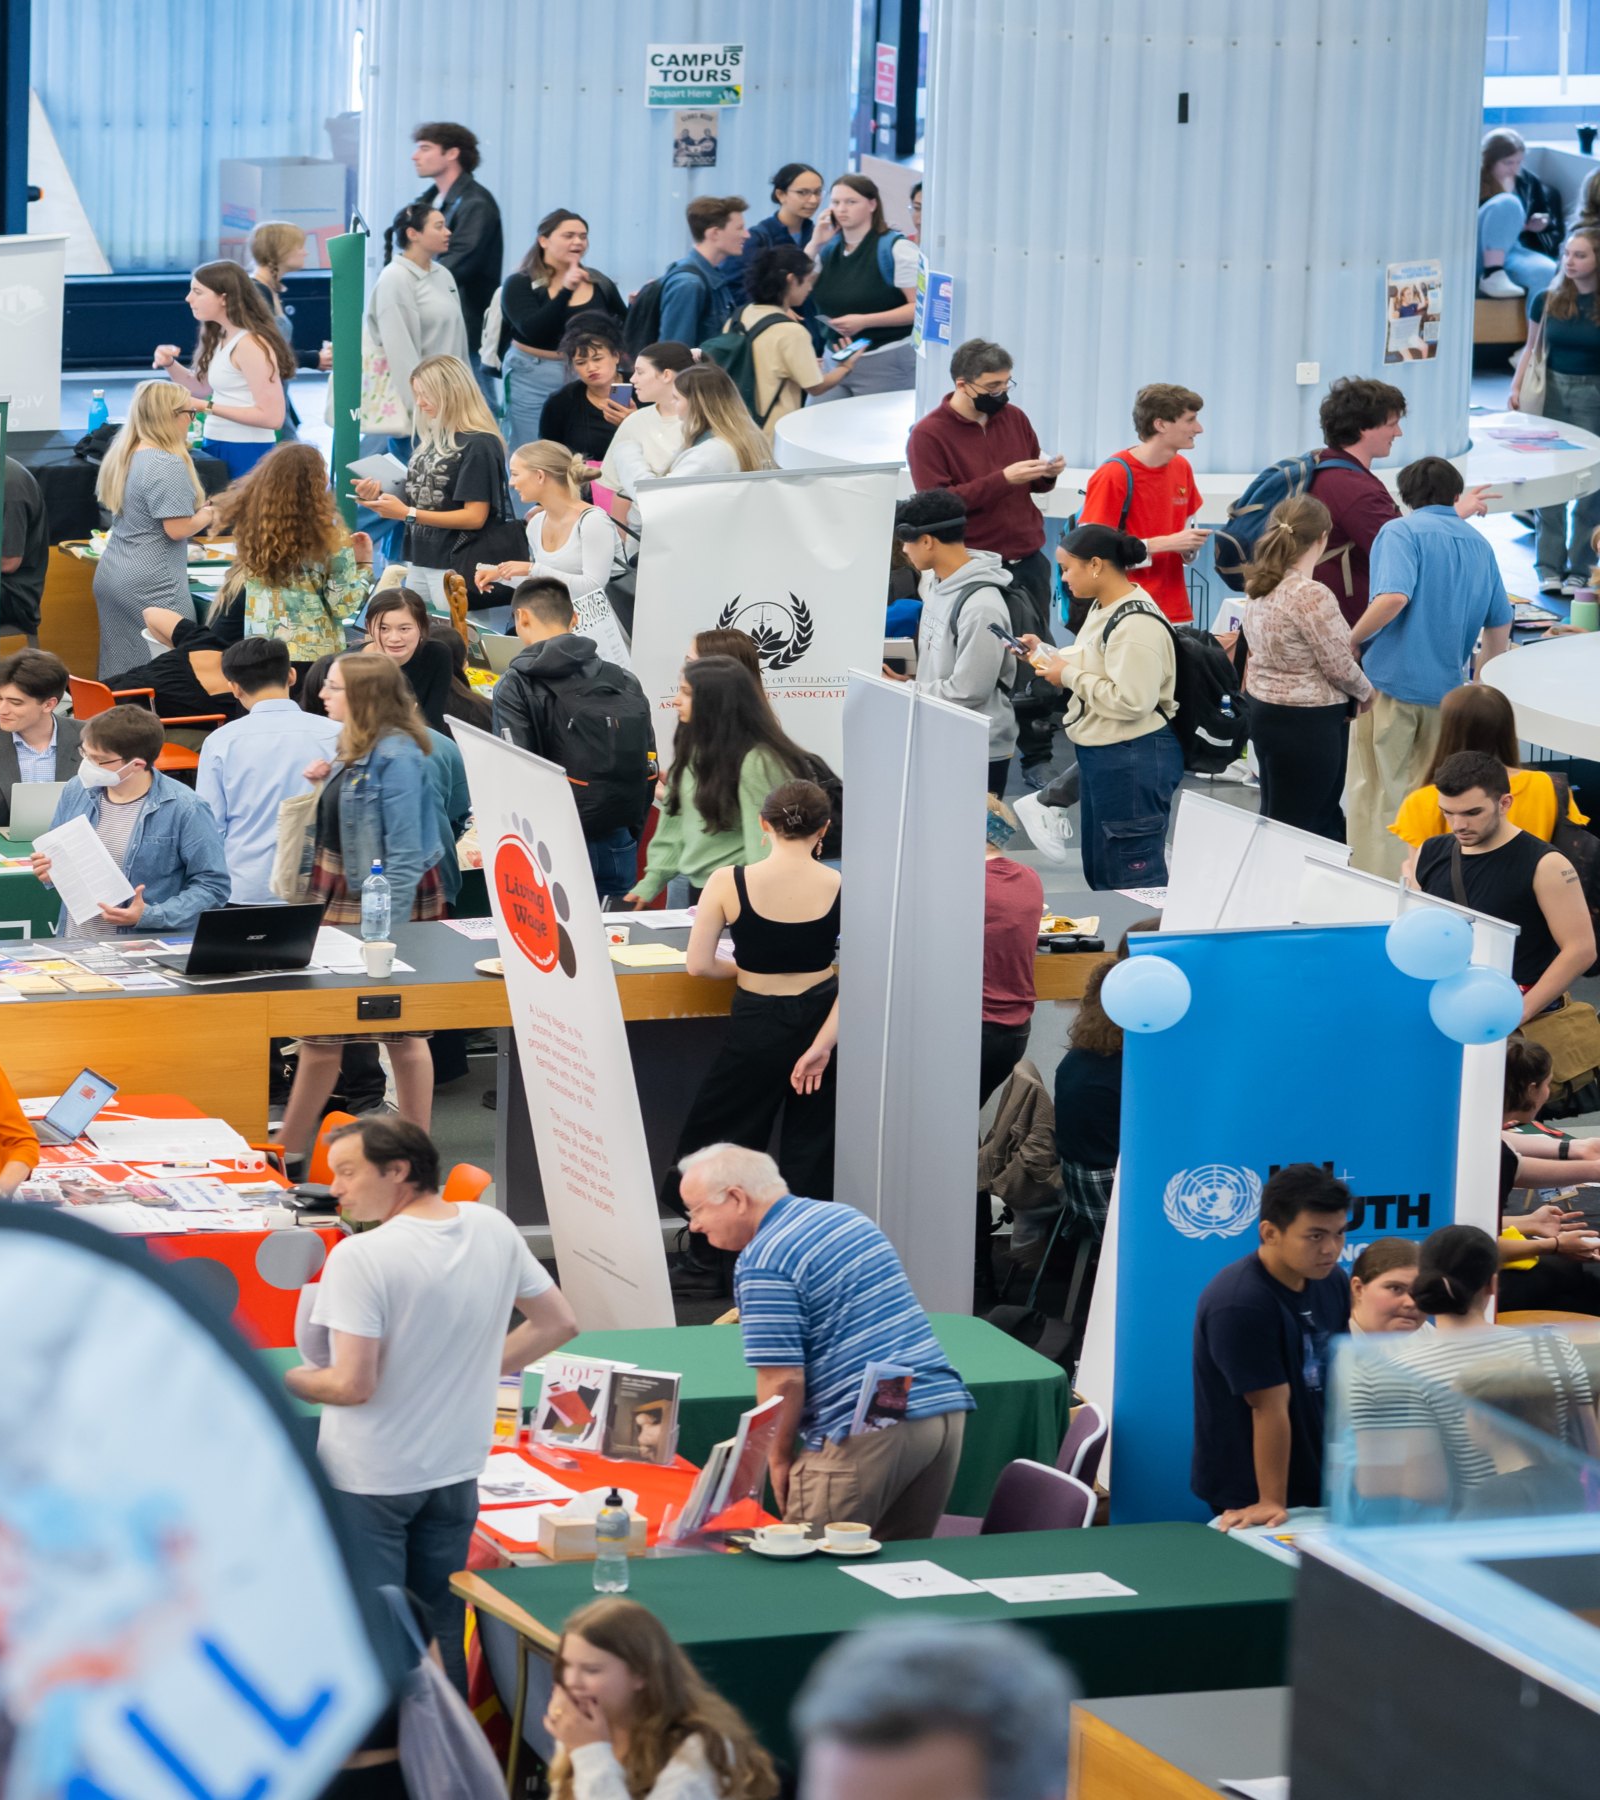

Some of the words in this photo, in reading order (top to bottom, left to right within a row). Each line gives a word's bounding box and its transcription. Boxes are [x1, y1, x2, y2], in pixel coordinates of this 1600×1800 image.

[650, 53, 741, 67] CAMPUS
[659, 69, 732, 83] TOURS
[649, 88, 685, 99] Depart
[687, 89, 712, 98] Here
[772, 676, 788, 684] OF
[504, 873, 545, 915] Living
[512, 902, 548, 938] Wage
[561, 1365, 604, 1388] 1917
